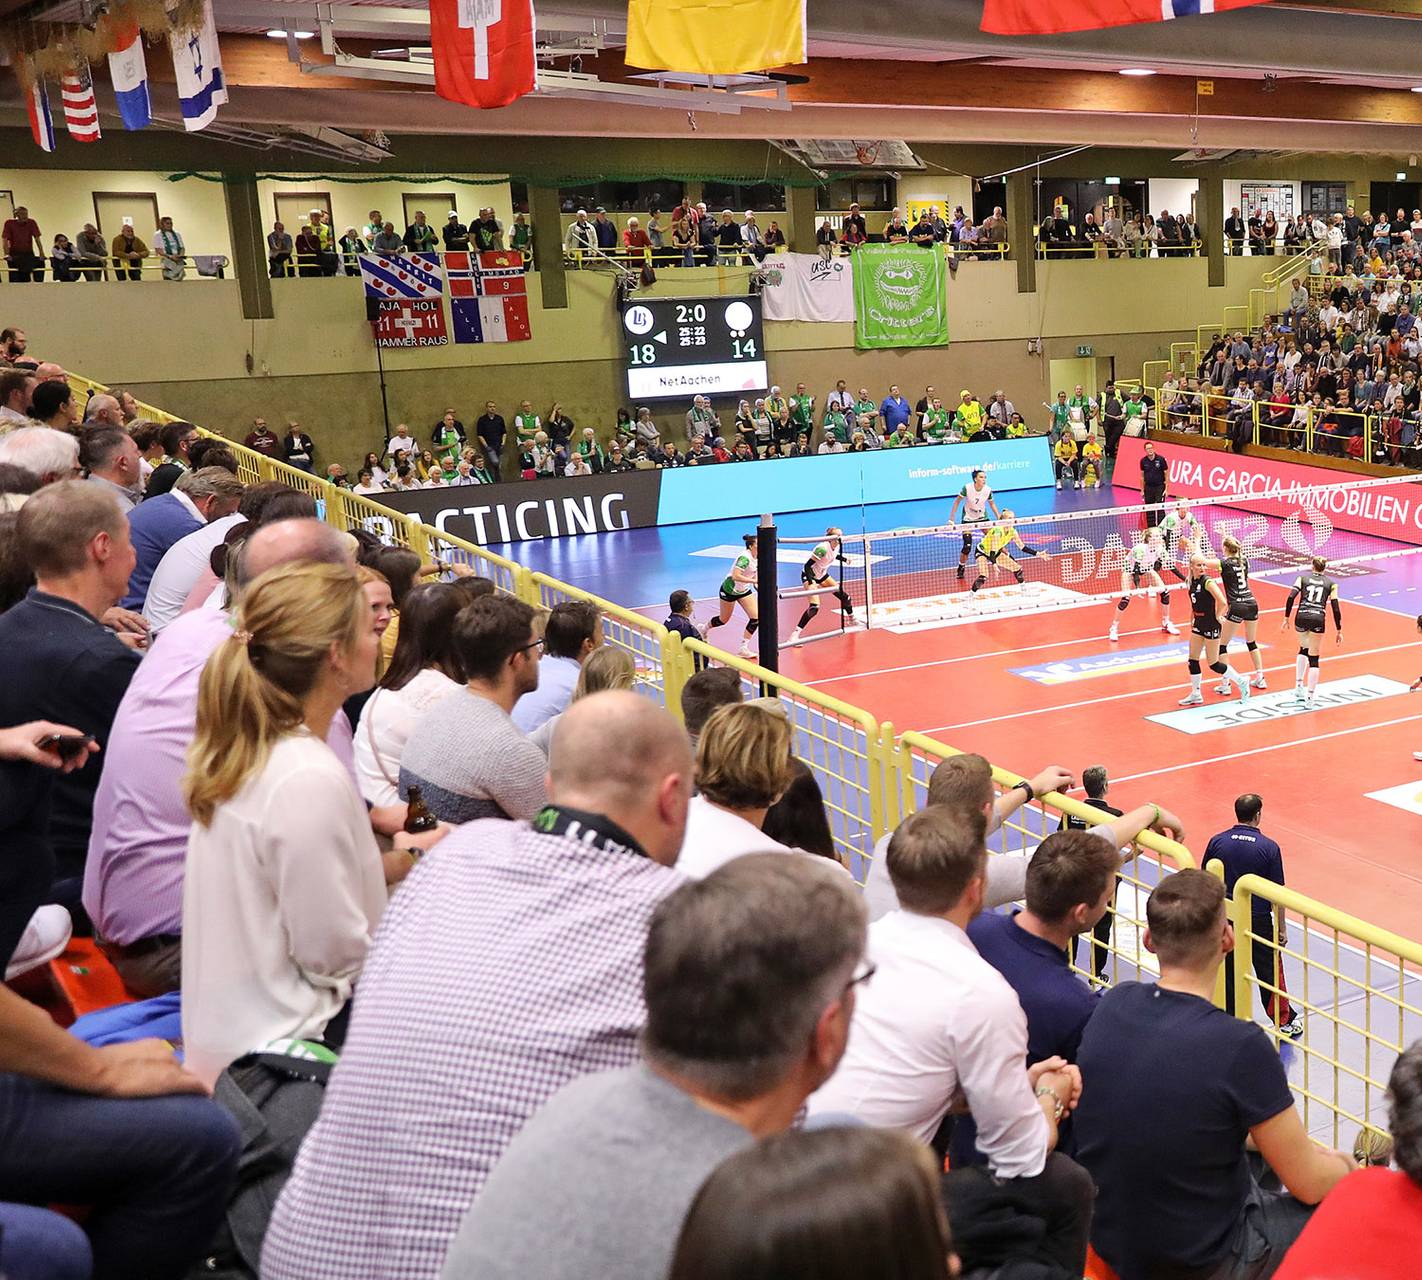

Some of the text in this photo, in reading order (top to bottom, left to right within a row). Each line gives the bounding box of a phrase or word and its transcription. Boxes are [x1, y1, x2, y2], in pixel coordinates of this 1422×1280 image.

[811, 259, 832, 273] USC
[503, 281, 510, 290] 9
[378, 301, 401, 311] AJA
[675, 304, 706, 323] 2:0
[425, 313, 439, 329] 11
[678, 326, 706, 337] 25:22
[419, 335, 448, 346] RAUS
[679, 336, 707, 347] 25:23
[732, 338, 757, 359] 14
[630, 344, 656, 365] 18
[659, 375, 721, 387] NetAachen
[908, 460, 1031, 479] inform-software.de/karriere
[1168, 459, 1204, 488] URA
[1208, 466, 1282, 499] GARCIA
[1287, 479, 1410, 525] IMMOBILIEN
[1235, 571, 1247, 590] 3
[1305, 585, 1324, 602] 11
